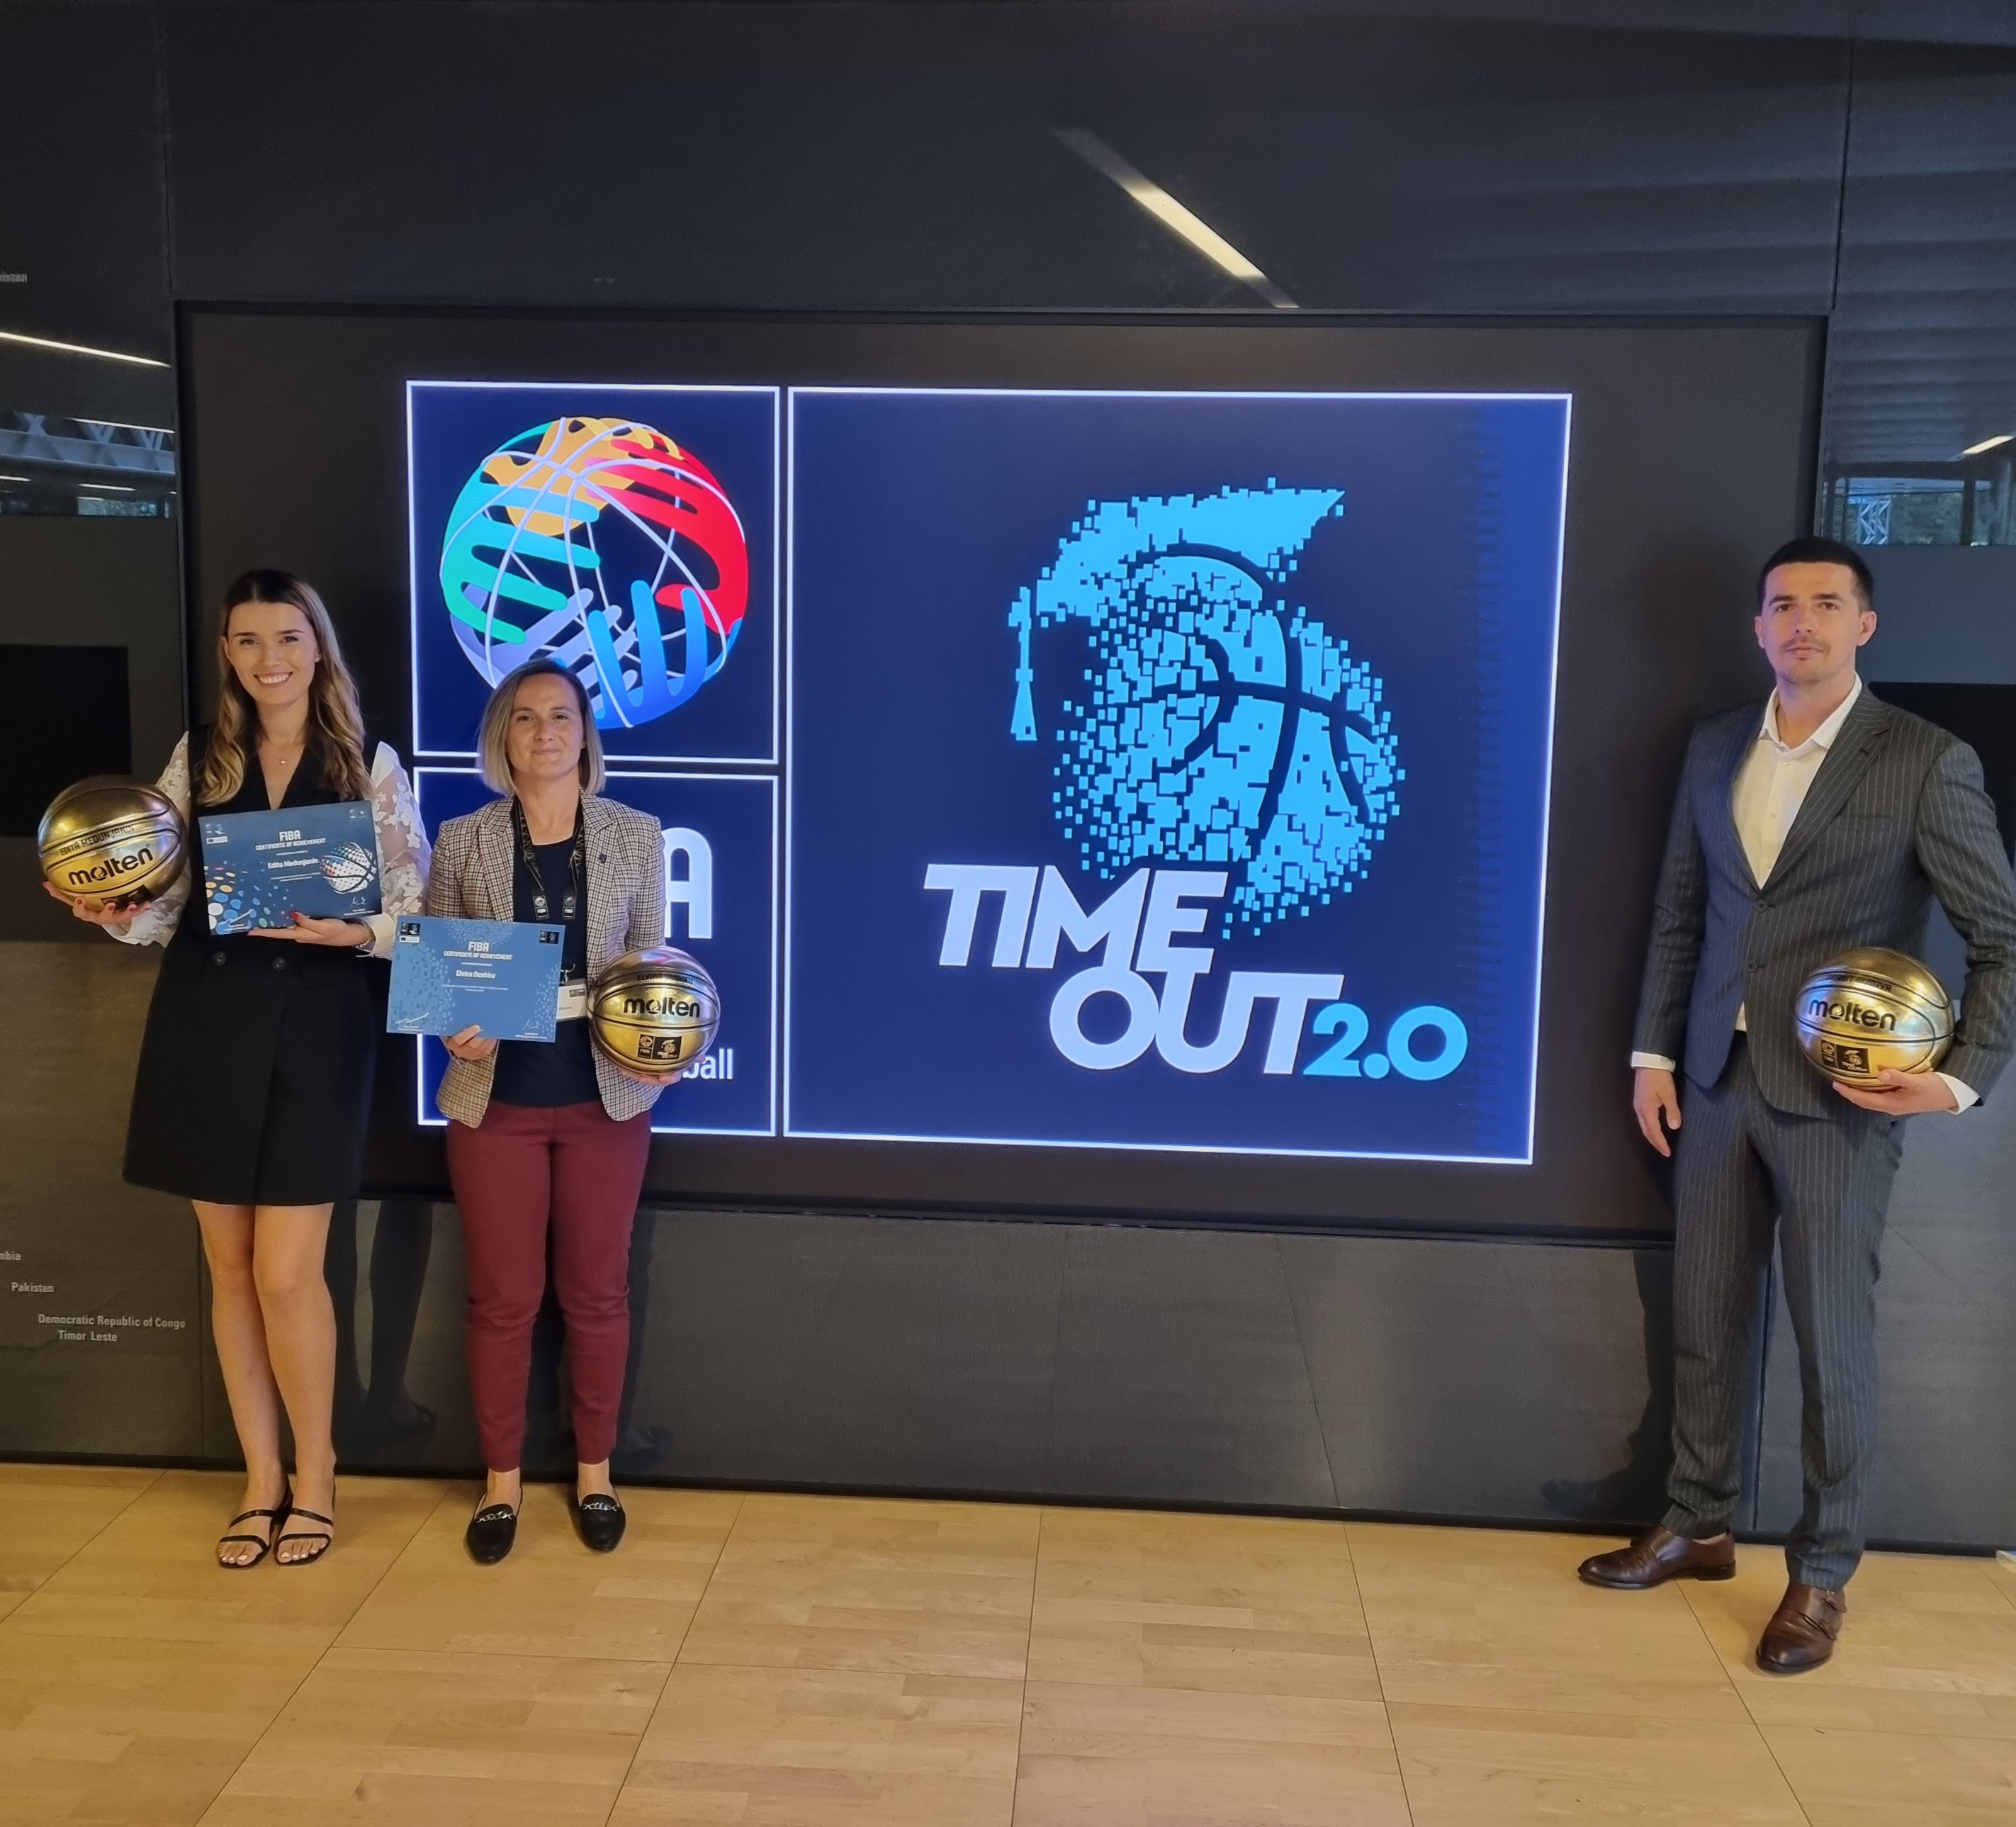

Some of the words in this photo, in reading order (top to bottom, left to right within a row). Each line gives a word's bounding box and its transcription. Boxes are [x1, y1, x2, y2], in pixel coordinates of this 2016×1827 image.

[278, 829, 301, 842] FIBA
[68, 848, 154, 885] molten
[924, 862, 1228, 974] TIME
[468, 940, 490, 952] FIBA
[623, 996, 700, 1018] molten
[1808, 999, 1896, 1031] molten
[11, 1281, 55, 1293] Pakistan
[38, 1313, 95, 1325] Democratic
[97, 1315, 141, 1328] Republic
[142, 1317, 153, 1327] of
[155, 1317, 186, 1330] Congo
[57, 1330, 86, 1341] Timor
[91, 1331, 118, 1342] Leste
